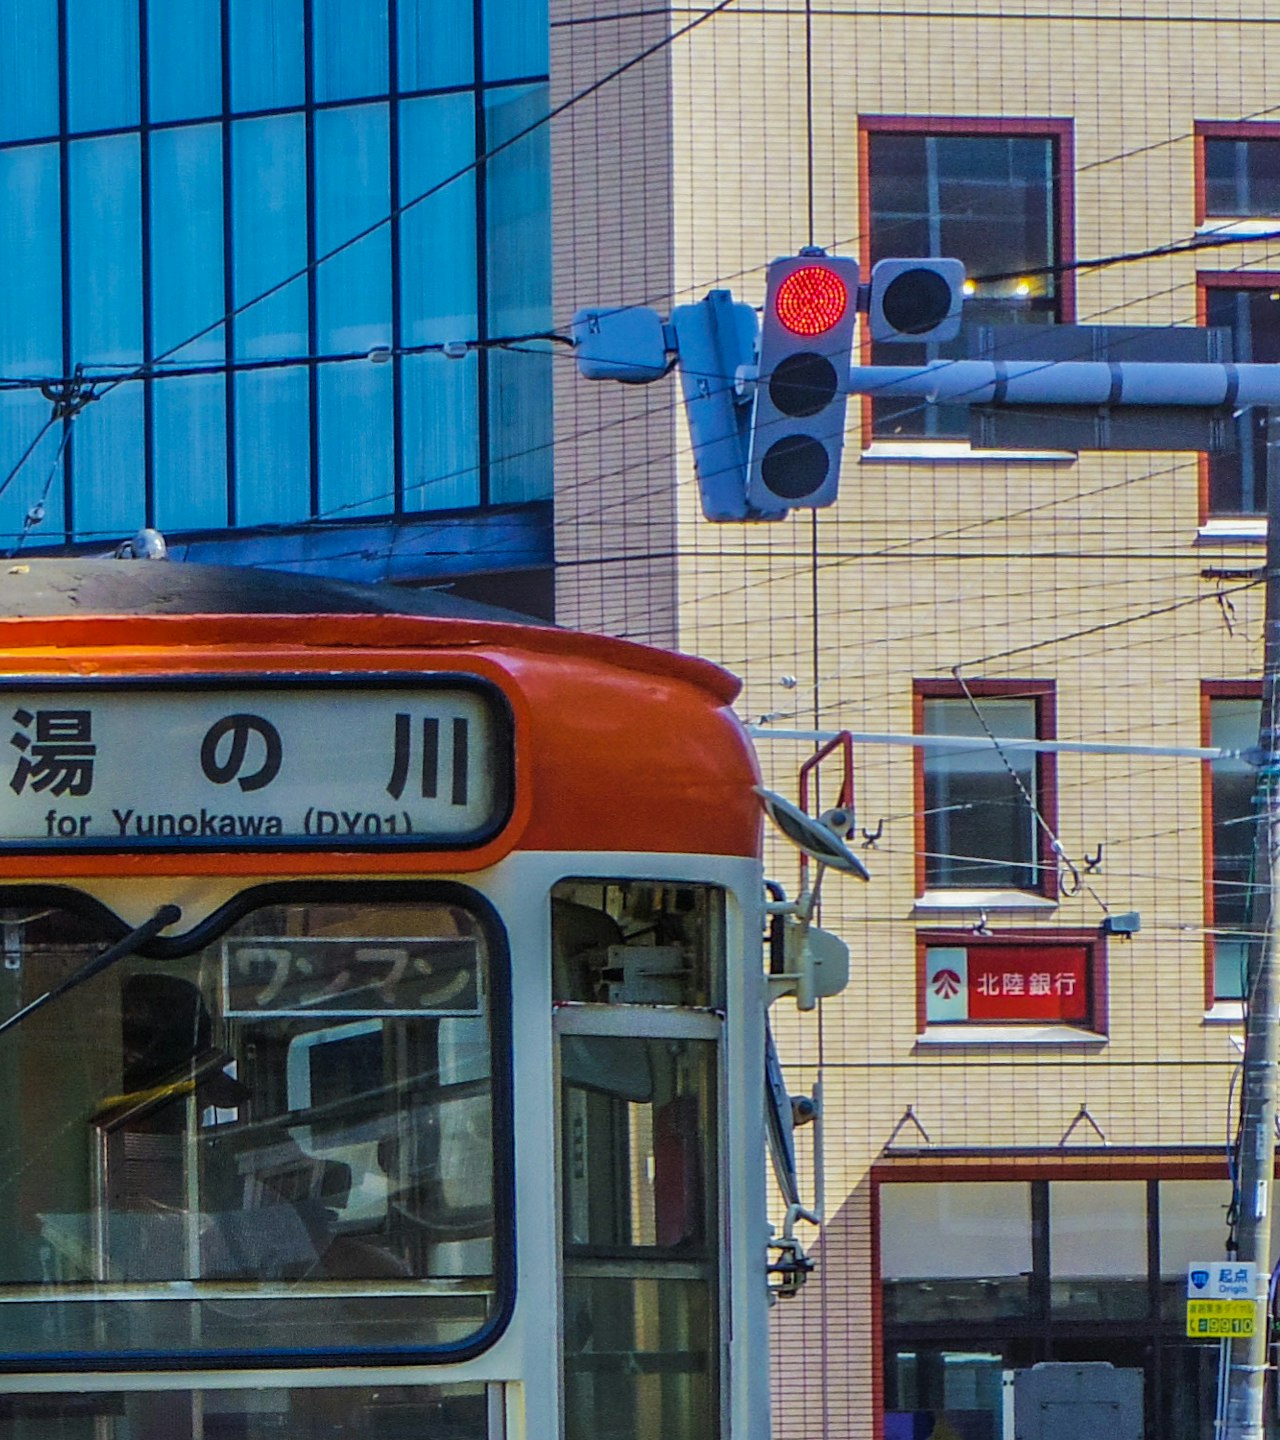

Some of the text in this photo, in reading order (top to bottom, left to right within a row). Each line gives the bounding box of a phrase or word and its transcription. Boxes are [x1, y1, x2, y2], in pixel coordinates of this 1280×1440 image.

[8, 708, 471, 807] 湯の川
[44, 809, 92, 837] for
[111, 808, 284, 837] Yunokawa
[236, 947, 471, 1007] ワンマン
[976, 971, 1078, 997] 北陸銀行
